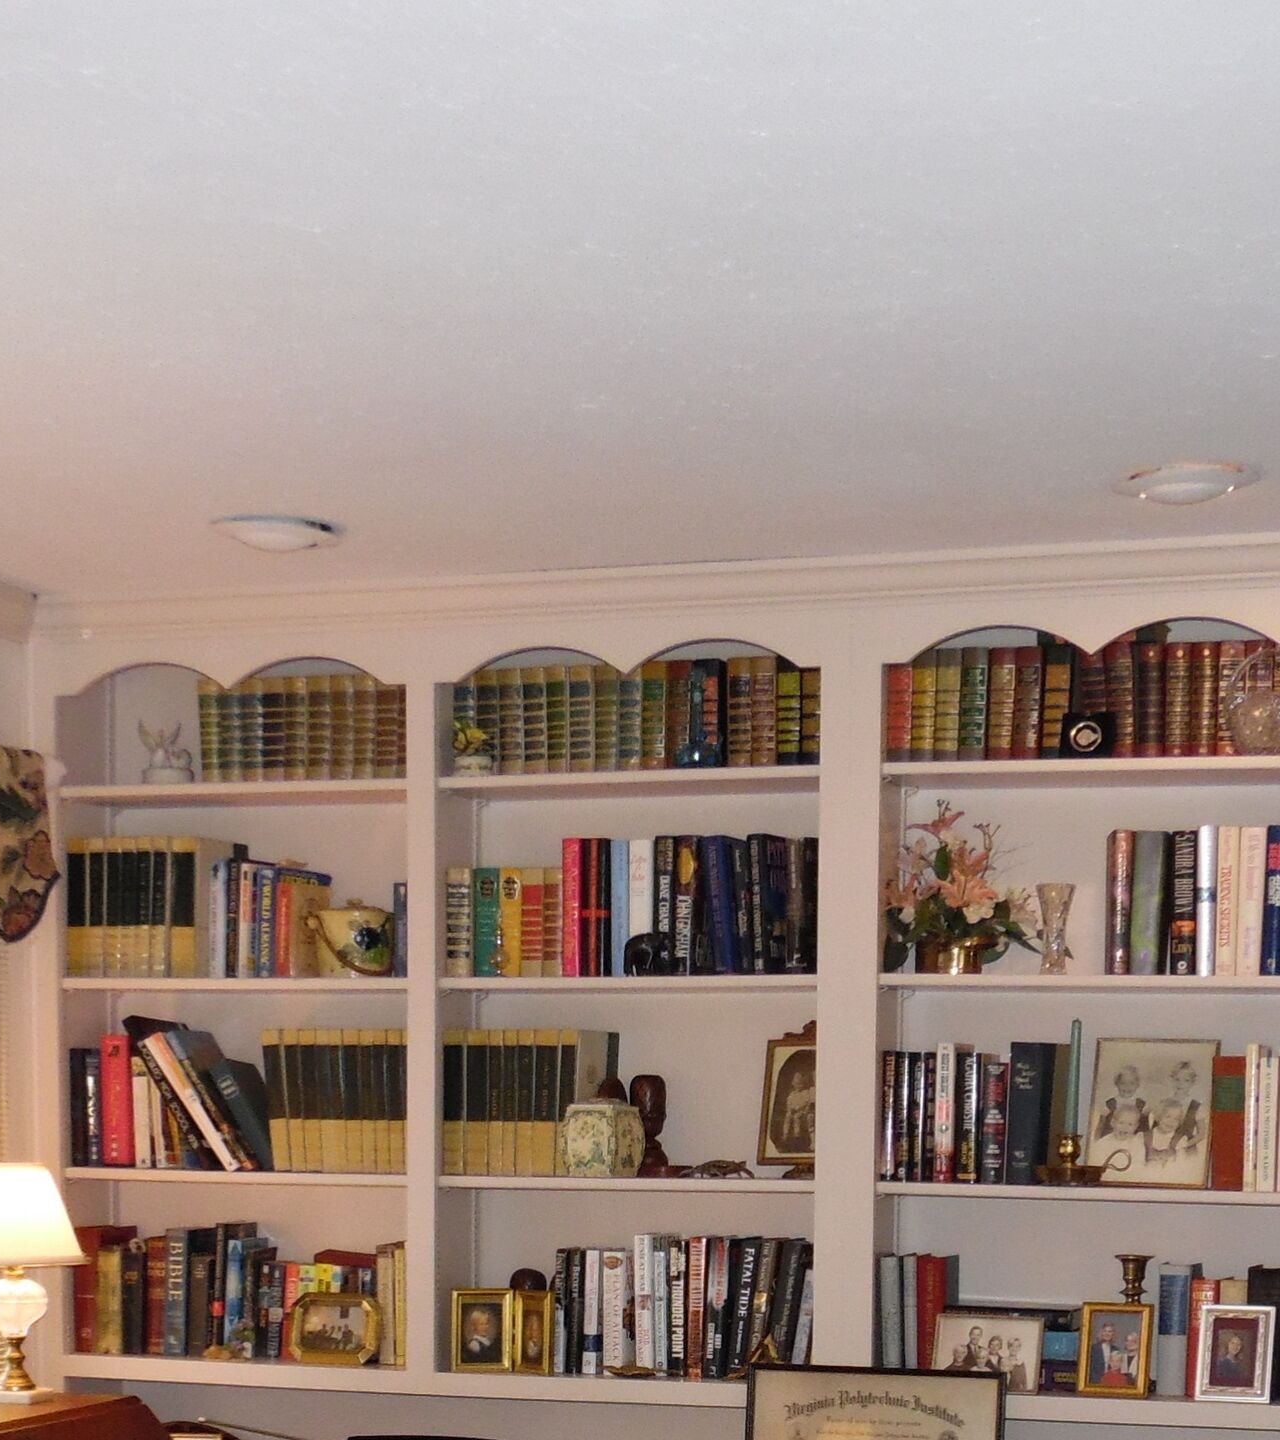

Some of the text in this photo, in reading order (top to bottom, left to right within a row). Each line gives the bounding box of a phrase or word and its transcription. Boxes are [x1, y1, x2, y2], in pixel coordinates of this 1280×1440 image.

[659, 875, 670, 899] DIANE
[1174, 834, 1195, 914] SANDRA BROWN
[1220, 864, 1232, 906] TRADING
[260, 884, 273, 966] WORLD ALMANAC
[674, 895, 693, 958] JOHN GRISHAM
[1219, 907, 1231, 948] SECRETS
[964, 1056, 975, 1091] AGATHA
[170, 1101, 190, 1132] SCHOOL
[963, 1092, 975, 1131] CHRISTIE
[168, 1242, 184, 1301] BIBLE
[638, 1273, 646, 1292] WAR
[740, 1247, 755, 1285] FATAL
[611, 1274, 623, 1361] PLAN OF ATTACK
[671, 1280, 684, 1326] THUNDER
[737, 1286, 751, 1318] TIDE
[671, 1327, 683, 1359] POINT
[784, 1397, 836, 1421] Virginia
[838, 1390, 911, 1409] Polytechnic
[911, 1395, 966, 1427] Institute
